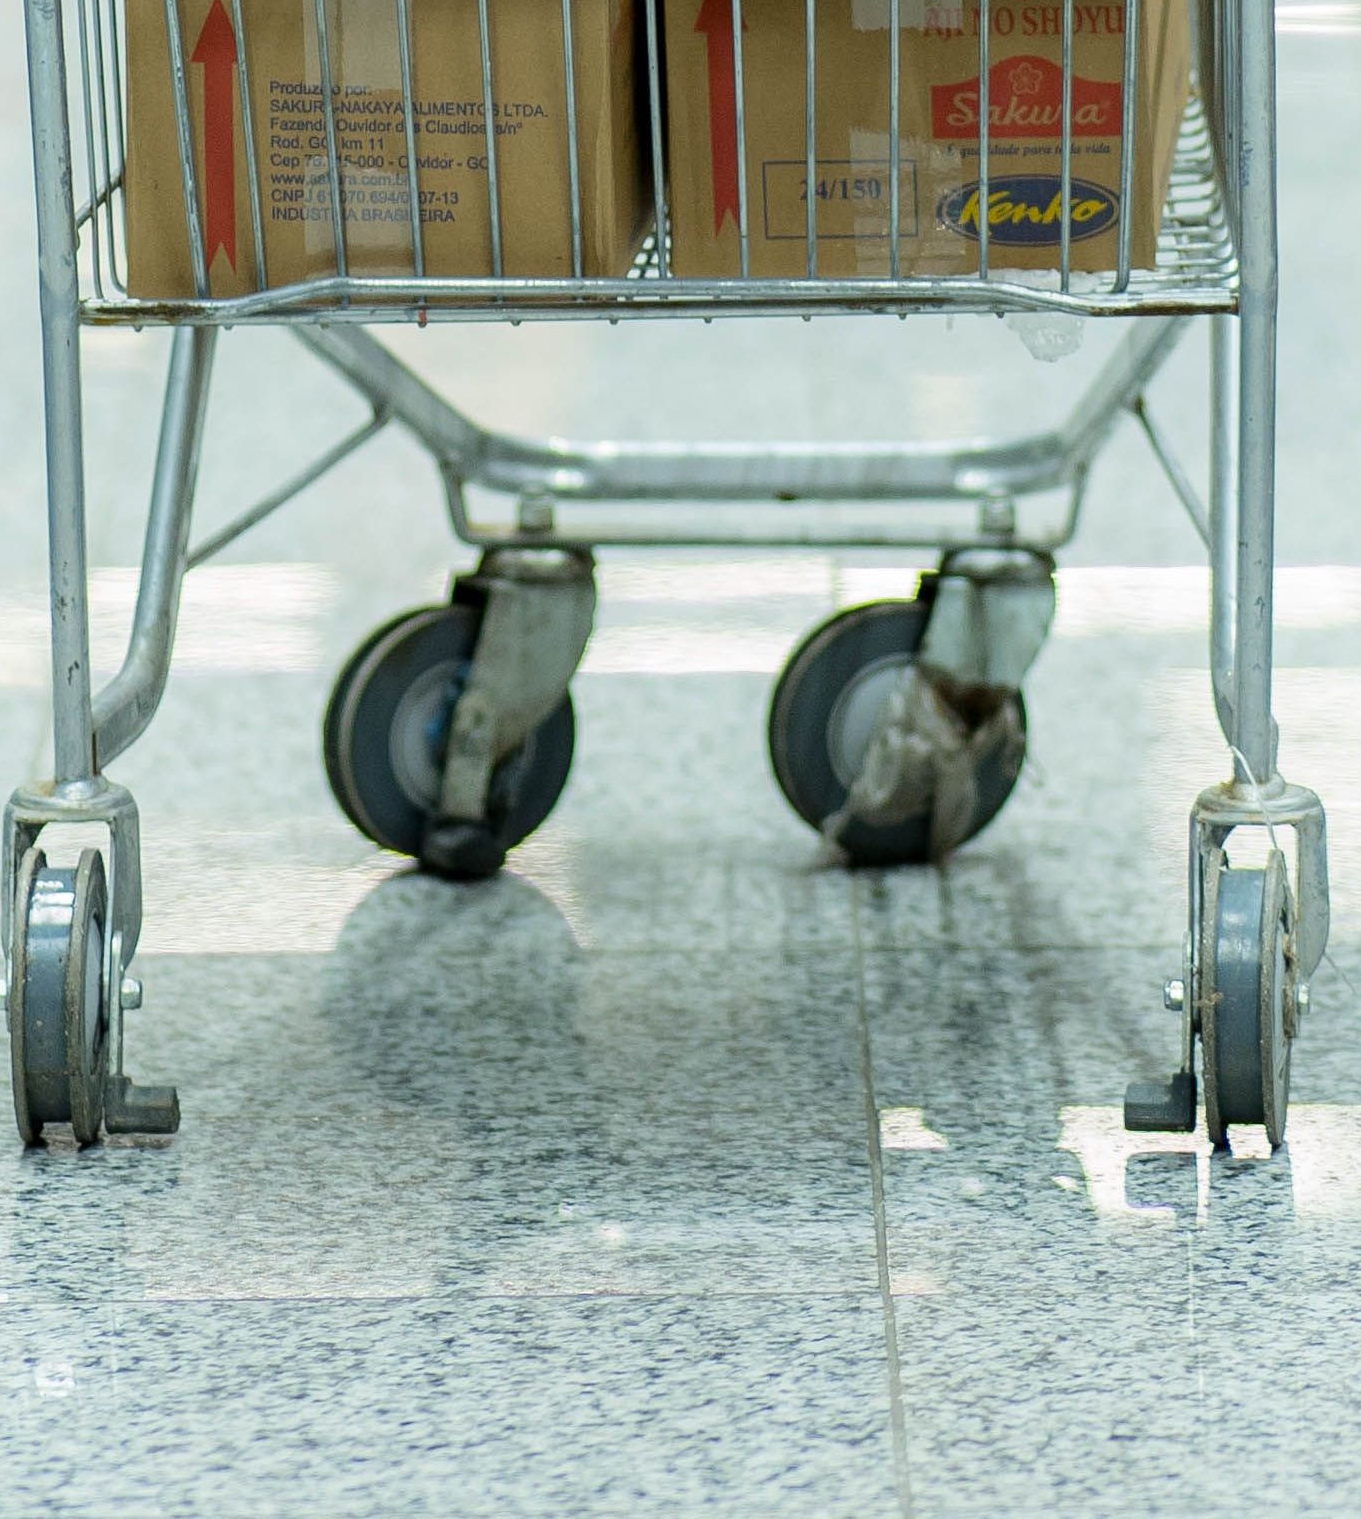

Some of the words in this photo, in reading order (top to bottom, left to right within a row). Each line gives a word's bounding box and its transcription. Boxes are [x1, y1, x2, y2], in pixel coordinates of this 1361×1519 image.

[269, 80, 341, 96] Produzo
[269, 99, 405, 114] SAKUR-NAKAYA
[503, 103, 549, 118] LTDA.
[945, 91, 1106, 127] Sakua
[269, 117, 330, 132] Fazend
[336, 118, 392, 132] Ouvidor
[395, 120, 421, 133] ds
[270, 135, 304, 149] Rod.
[341, 136, 363, 150] km
[369, 137, 384, 150] 11
[269, 153, 300, 170] Cep
[398, 155, 454, 170] Ovidor
[271, 189, 313, 203] CNPJ
[362, 208, 456, 223] BRASIEIRA
[957, 189, 1109, 236] Kenko
